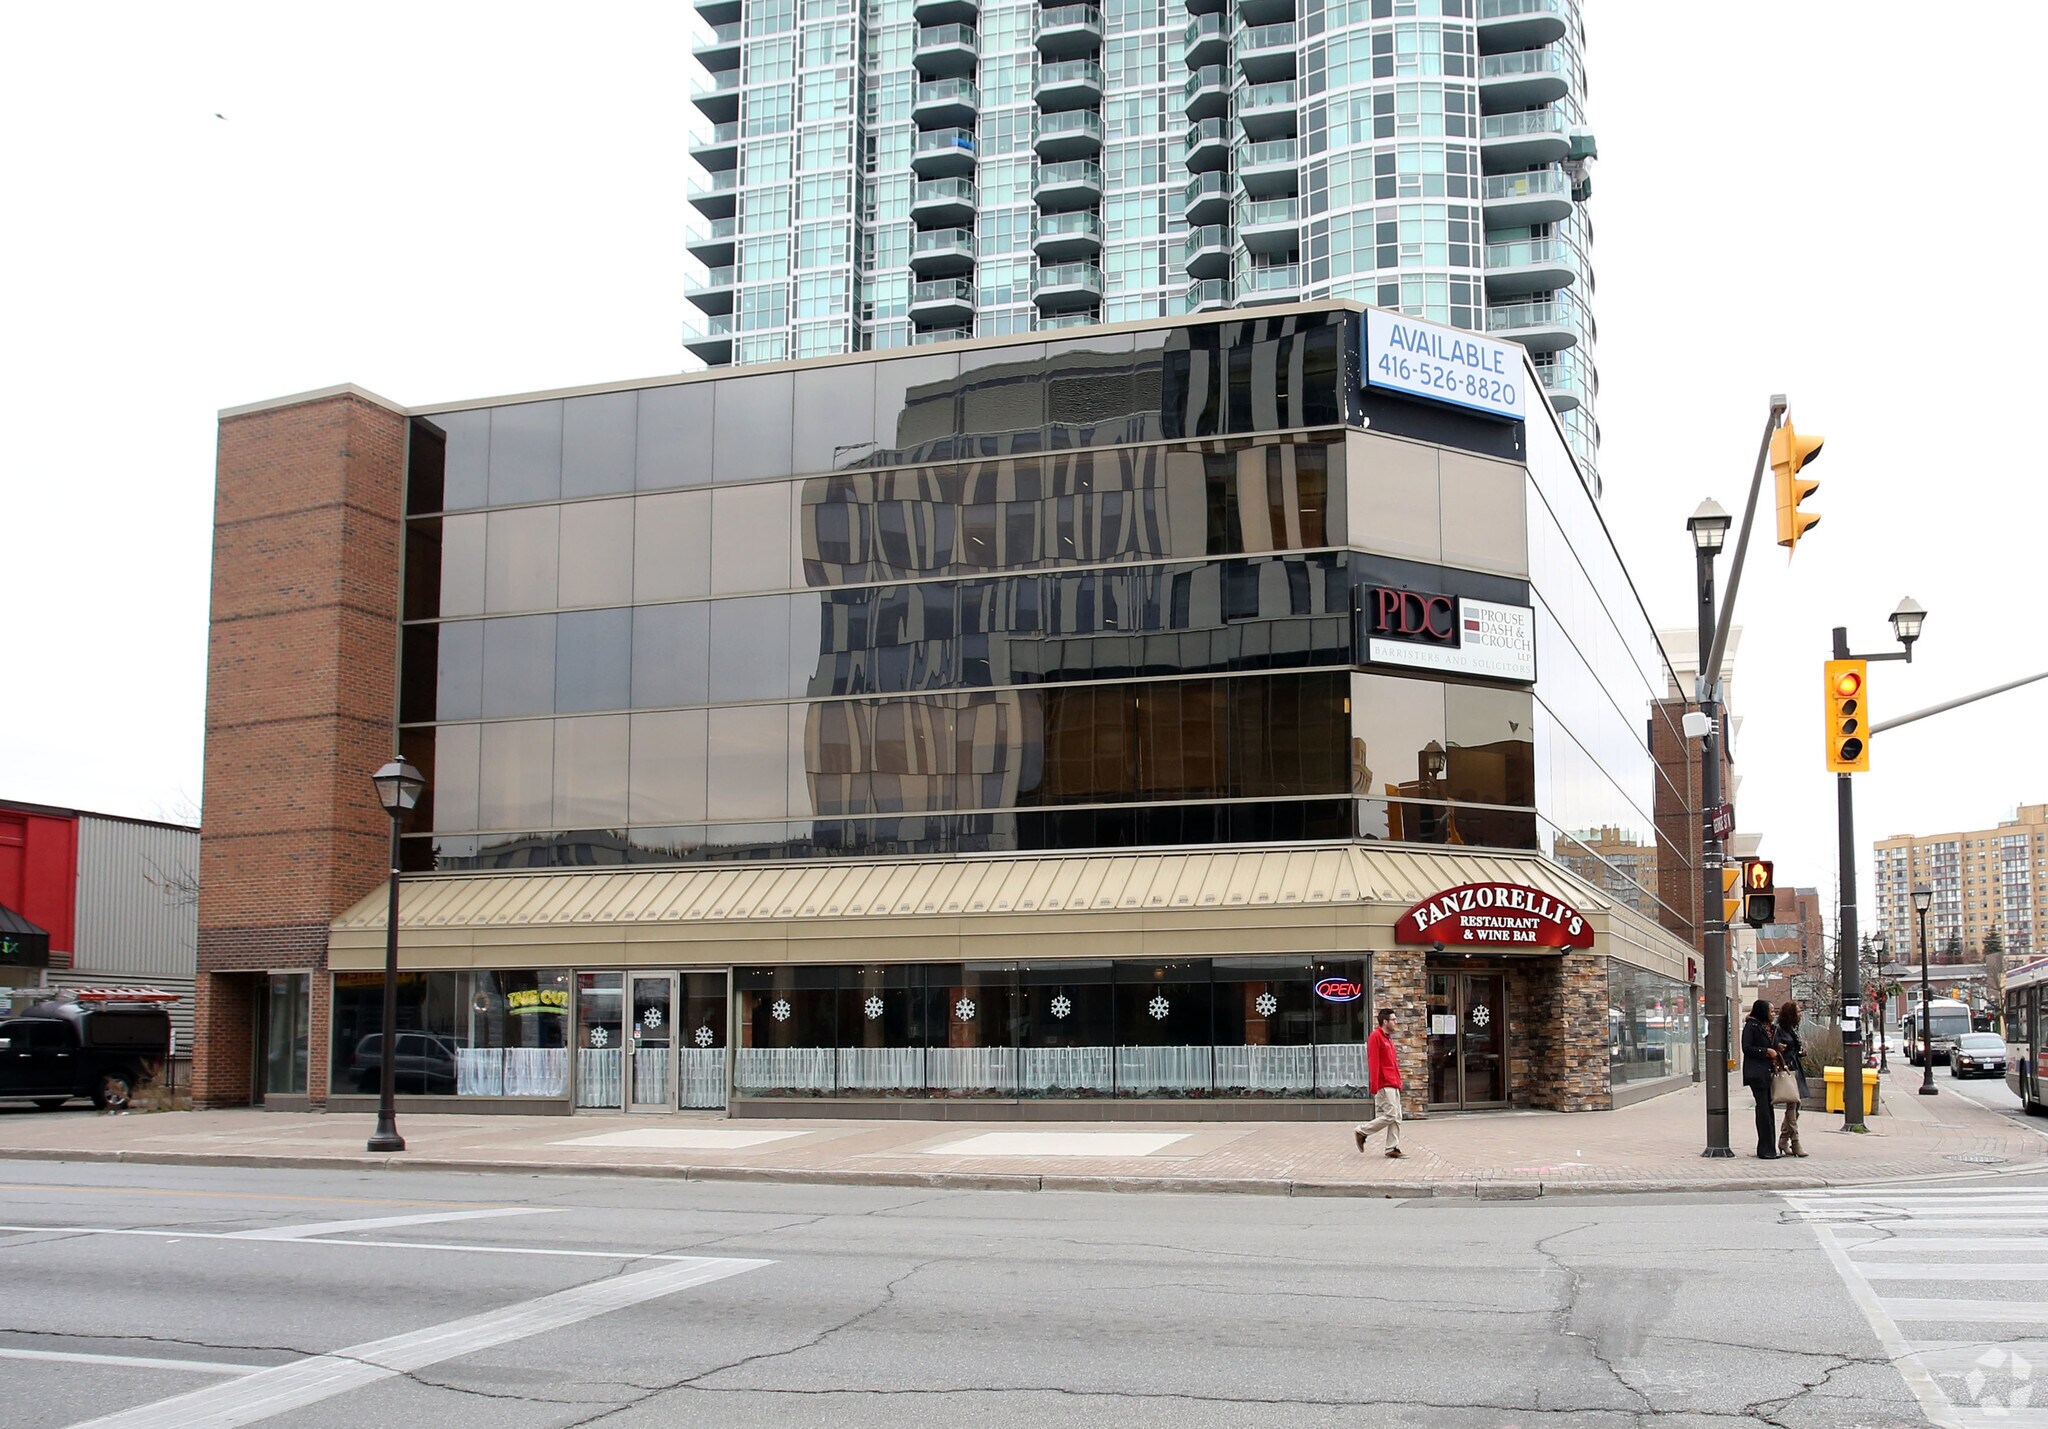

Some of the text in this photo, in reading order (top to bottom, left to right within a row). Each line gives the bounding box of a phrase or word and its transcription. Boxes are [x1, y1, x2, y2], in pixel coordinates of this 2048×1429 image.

[1389, 324, 1505, 375] AVAILABLE
[1378, 353, 1516, 406] 416-526-8820
[1376, 588, 1453, 639] PDC
[1481, 609, 1525, 627] PROUSE
[1481, 621, 1525, 639] DASH &
[1481, 634, 1531, 652] CROUCH
[1375, 646, 1531, 674] BARRISTERS AND SOLICITORS
[1517, 652, 1531, 662] LLP
[1411, 886, 1584, 936] FANZORELLI'S
[1459, 915, 1541, 929] RESTAURANT
[1463, 928, 1537, 942] & WINE BAR
[540, 989, 568, 1007] OUT
[1318, 983, 1361, 996] OPEN
